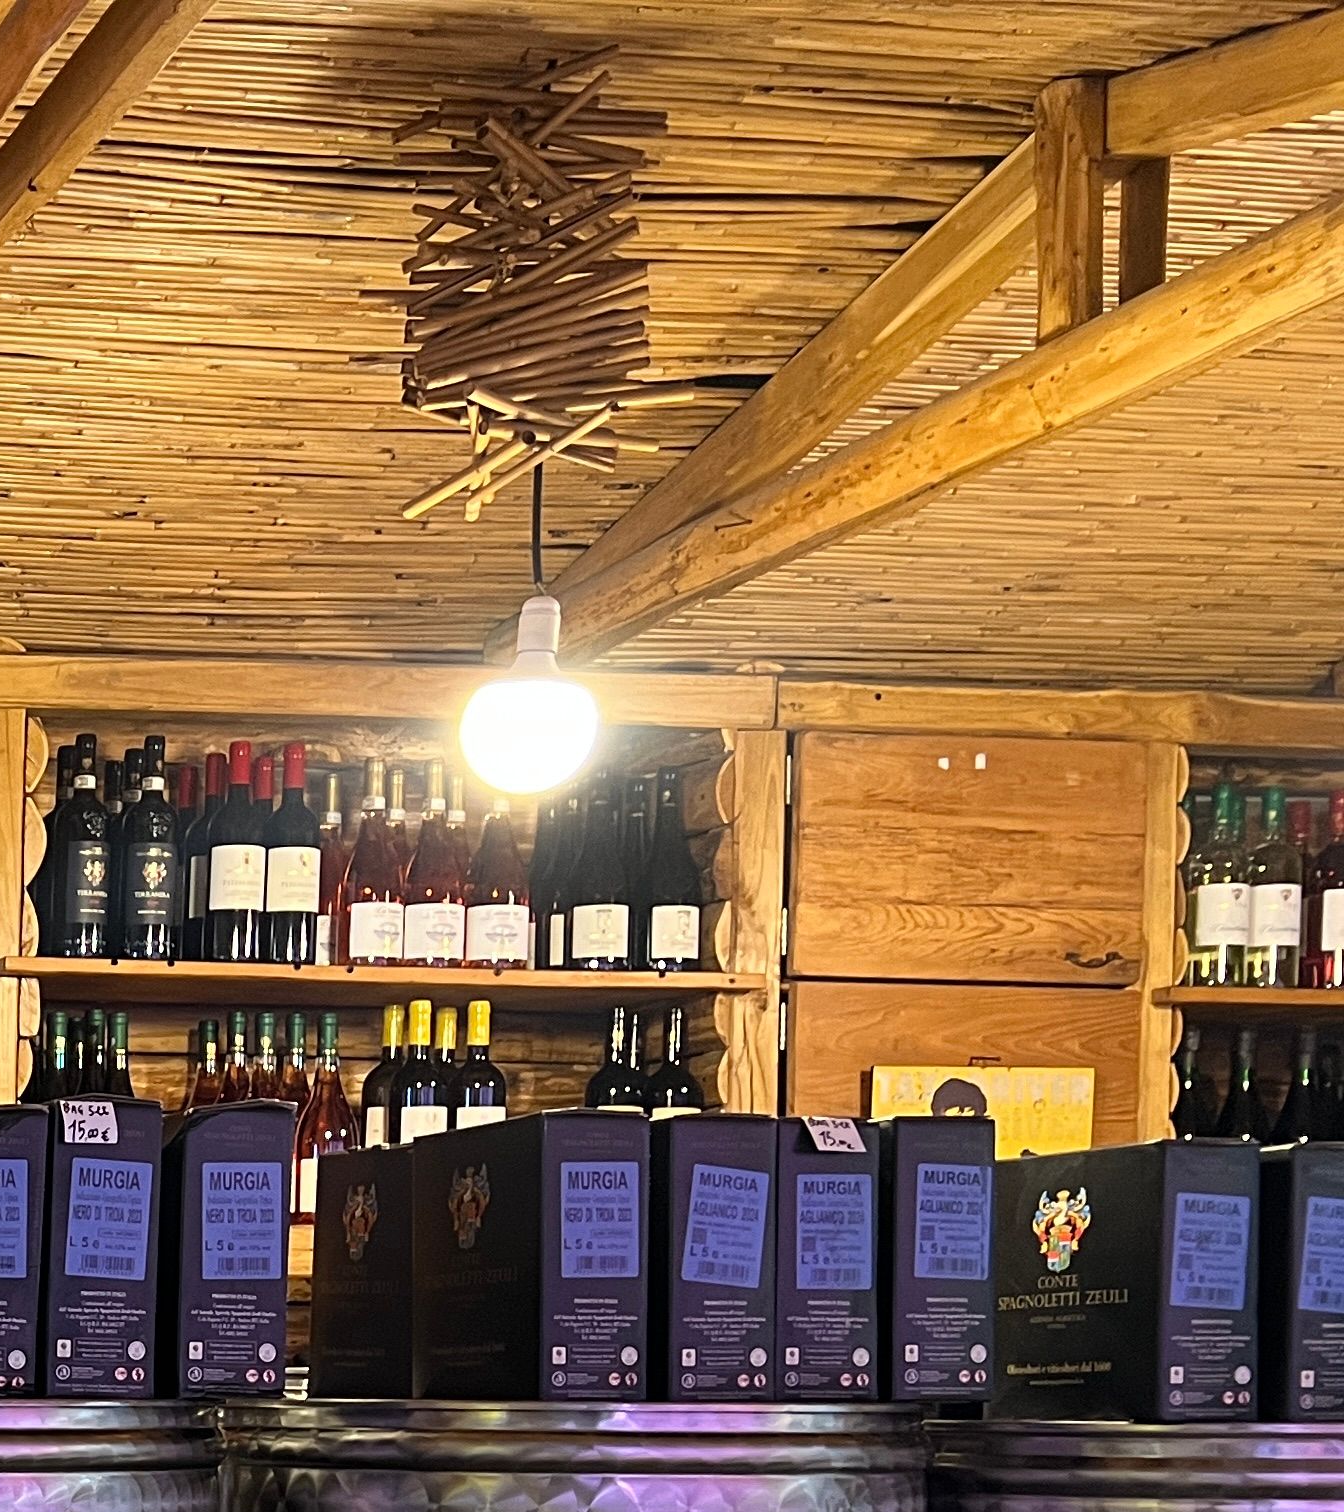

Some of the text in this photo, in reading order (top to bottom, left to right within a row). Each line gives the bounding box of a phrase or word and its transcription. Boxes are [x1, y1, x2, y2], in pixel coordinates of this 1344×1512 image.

[63, 1102, 84, 1115] BAG
[78, 1167, 141, 1191] MURGIA
[209, 1171, 271, 1192] MURGIA
[568, 1171, 629, 1191] MURGIA
[700, 1172, 759, 1193] MURGIA
[803, 1181, 862, 1196] MURGIA
[923, 1170, 981, 1187] MURGIA
[1037, 1275, 1079, 1289] CONTE
[997, 1288, 1129, 1311] SPAGNOLETTI ZEULI
